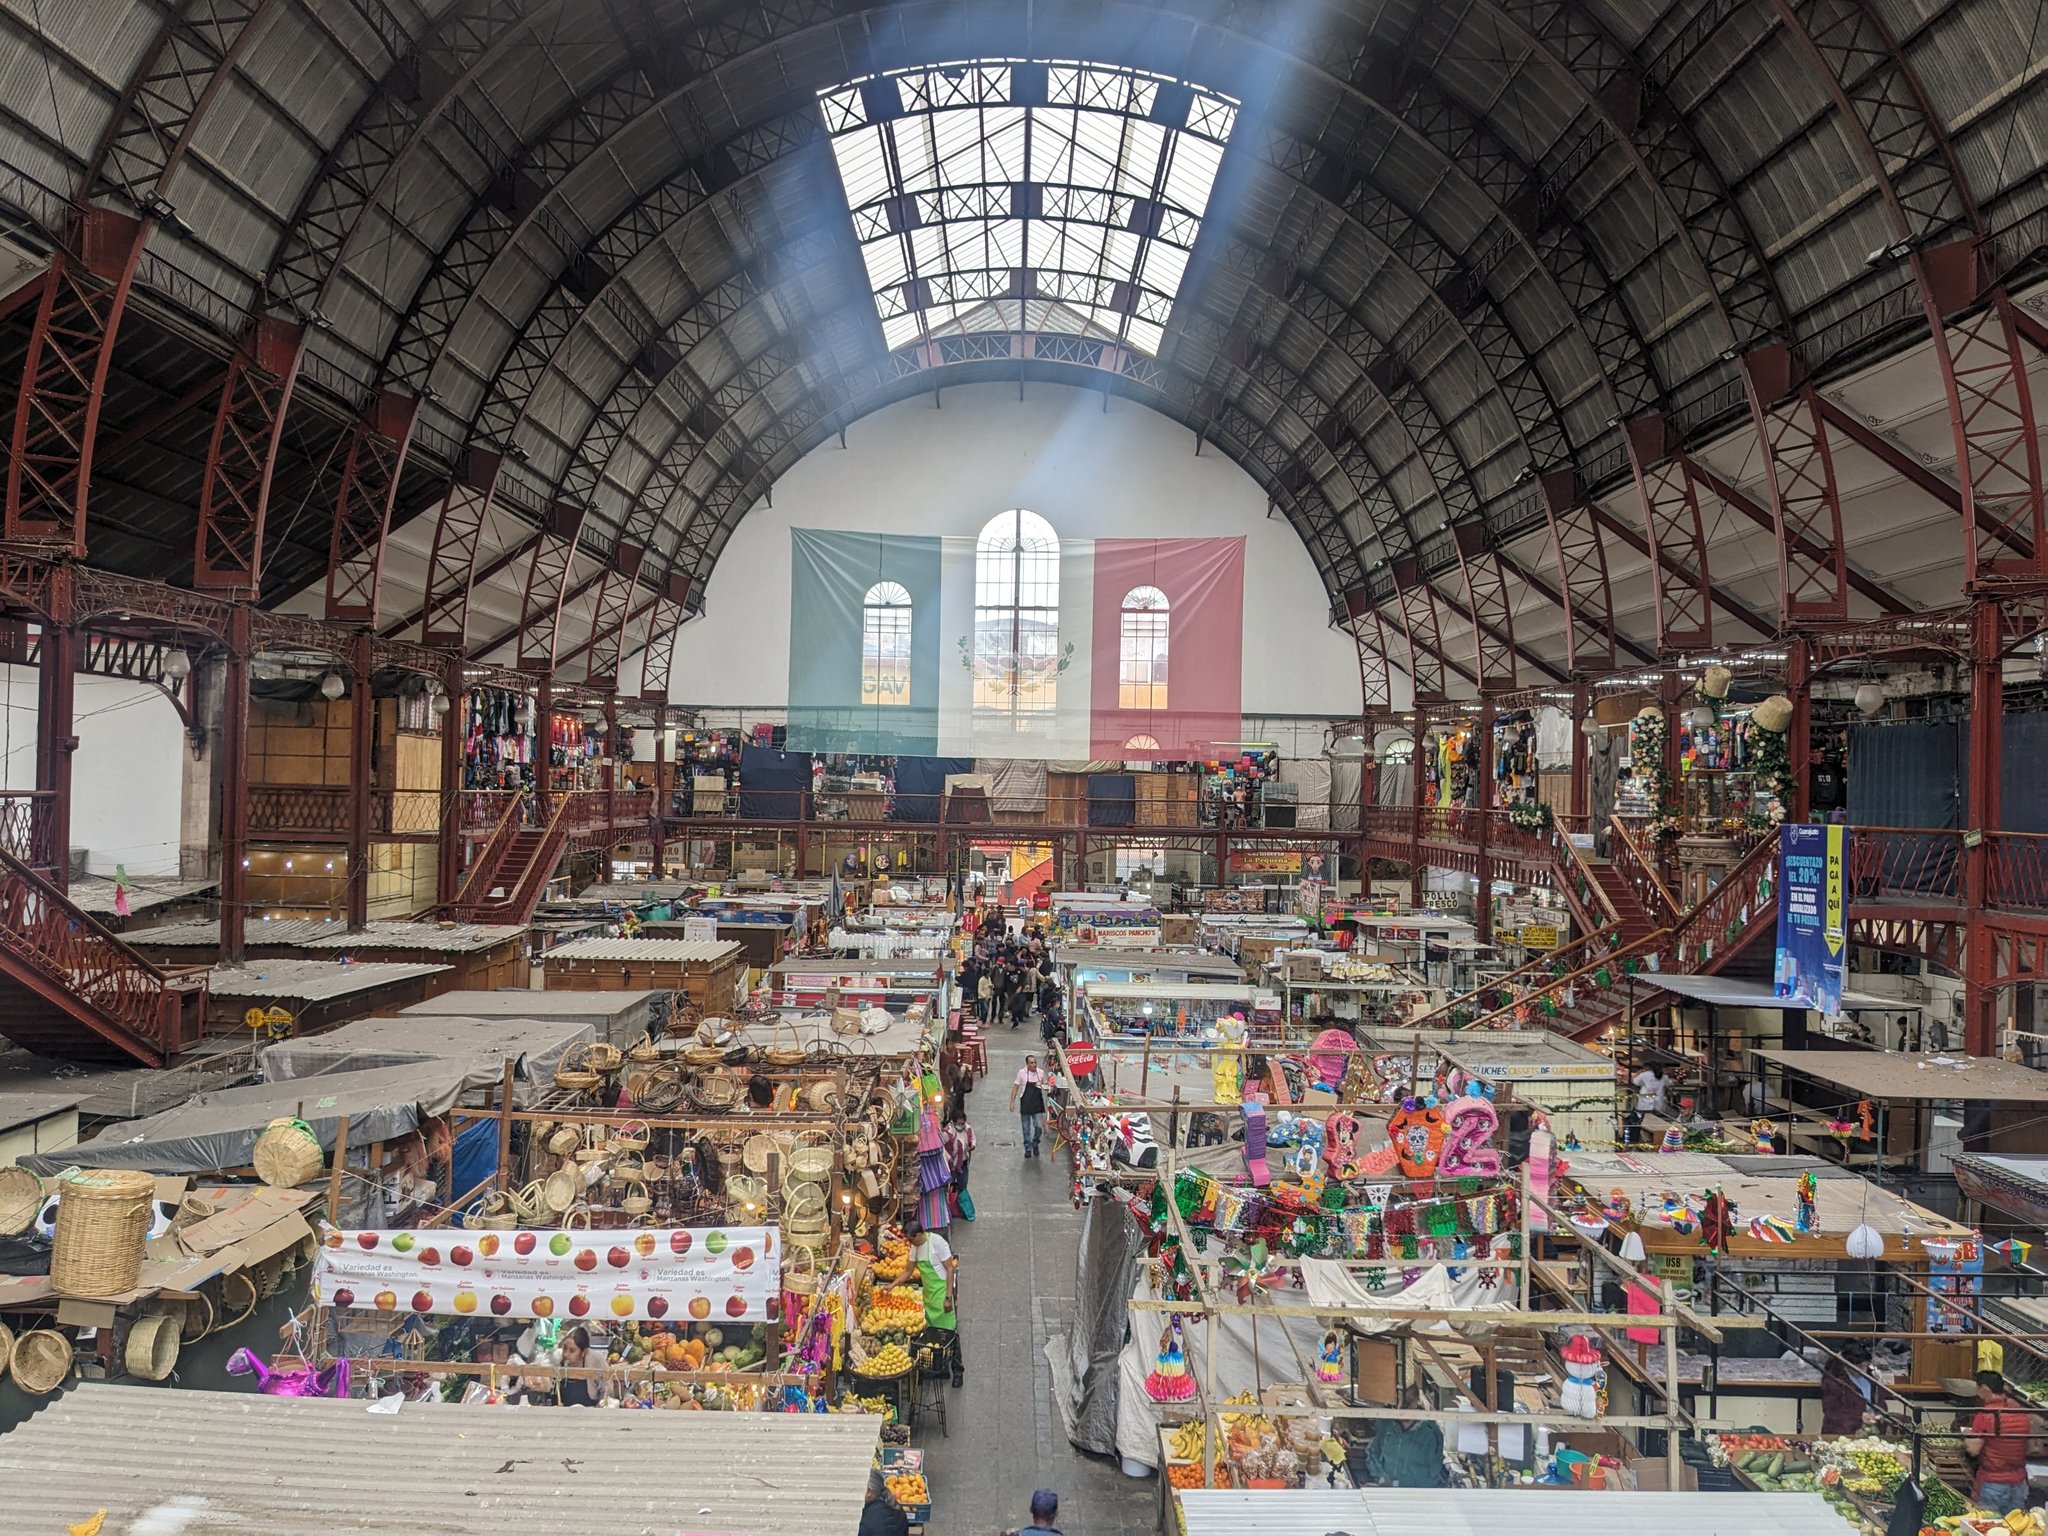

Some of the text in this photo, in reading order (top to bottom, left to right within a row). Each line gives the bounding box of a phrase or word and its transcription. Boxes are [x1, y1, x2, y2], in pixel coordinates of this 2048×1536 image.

[639, 846, 651, 855] EL
[1829, 856, 1839, 865] PA
[1788, 867, 1820, 884] DEL 20%!
[1829, 871, 1839, 880] GA
[1831, 885, 1837, 894] A
[1424, 891, 1456, 900] POLLO
[1790, 892, 1816, 903] EN EL PAGO
[1828, 898, 1840, 910] QUÍ
[1793, 913, 1800, 925] TU
[1800, 914, 1820, 927] PREDIAL
[1097, 929, 1156, 937] MARISCOS PANCHO'S
[1508, 1066, 1540, 1075] CASSETS
[1540, 1066, 1550, 1075] DE
[1551, 1066, 1613, 1075] SUPERNINTENDO
[1982, 1176, 2016, 1196] PESCADOS
[1666, 1257, 1681, 1268] USB
[343, 1263, 393, 1272] Variedad es
[658, 1268, 693, 1276] Variedad
[376, 1271, 419, 1279] Washington.
